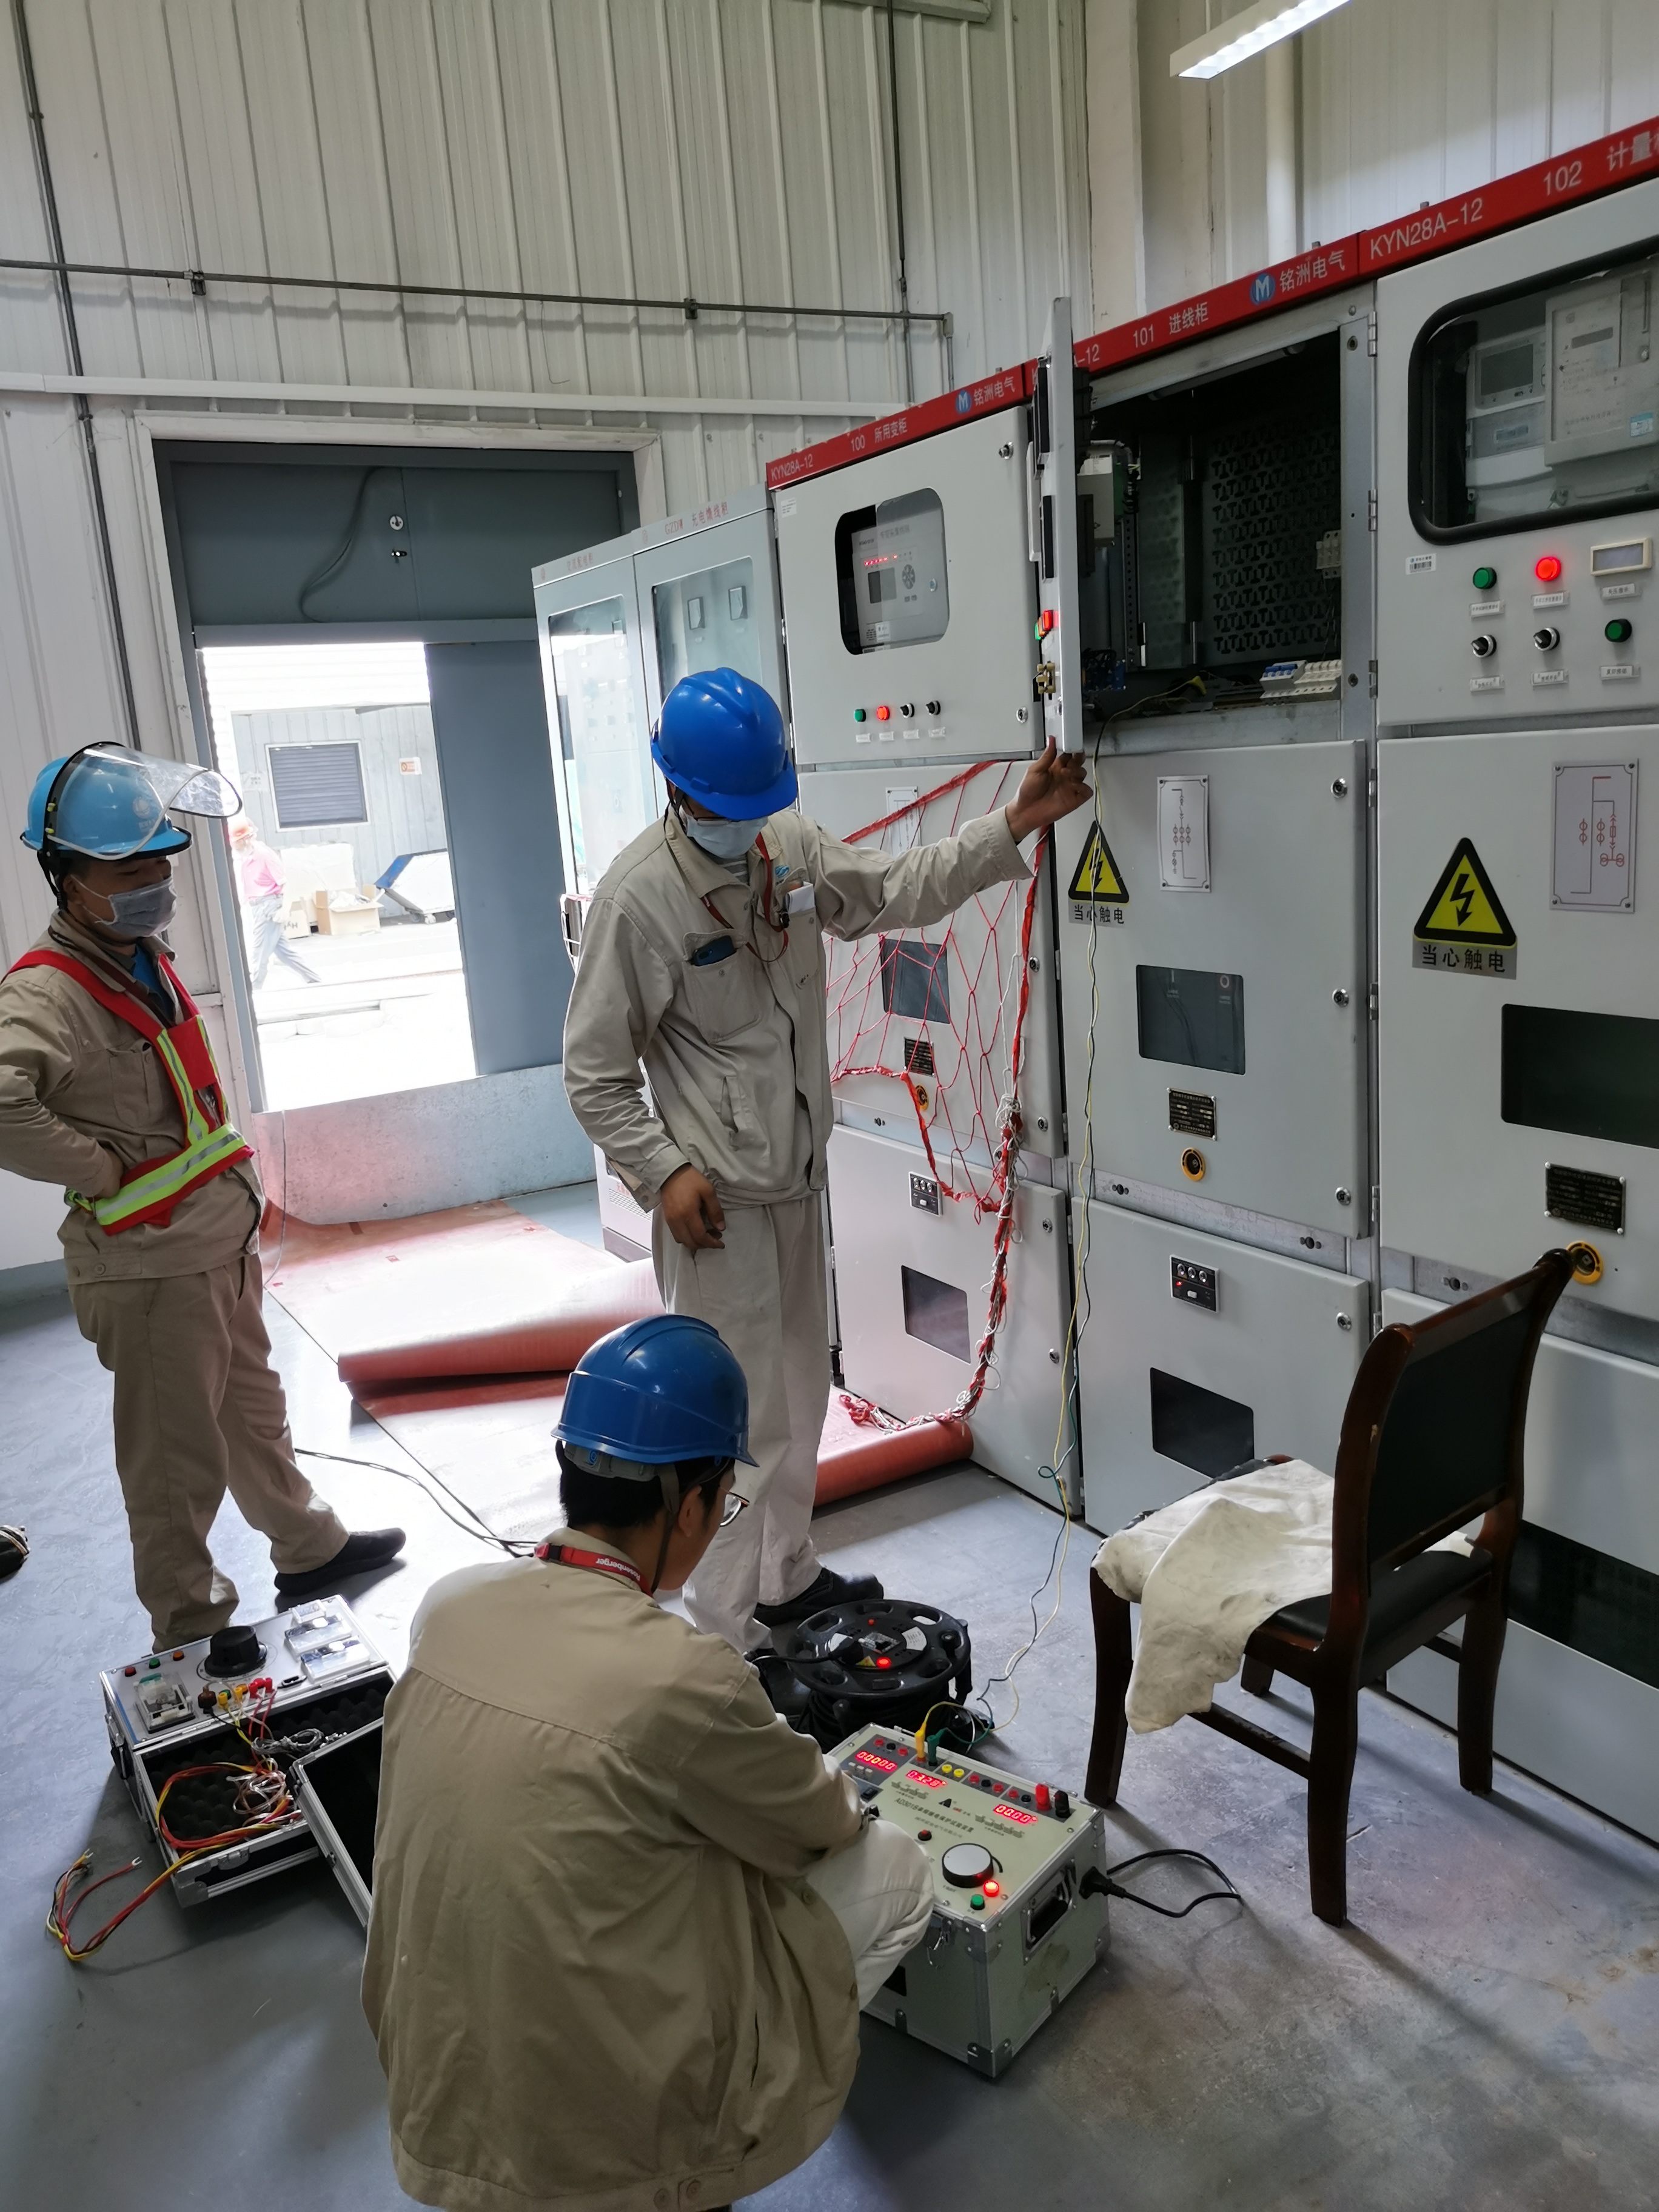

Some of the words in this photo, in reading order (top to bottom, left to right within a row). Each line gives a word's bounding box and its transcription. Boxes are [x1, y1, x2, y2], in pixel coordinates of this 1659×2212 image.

[1370, 197, 1483, 260] KYN28A-12
[1543, 160, 1583, 196] 102
[1133, 324, 1154, 348] 101
[1168, 302, 1209, 335] 进线柜
[1279, 249, 1347, 293] 铭洲电气
[771, 454, 813, 481] KYN28A-12
[851, 435, 865, 452] 100
[874, 417, 908, 443] 所用变柜
[973, 376, 1016, 406] 铭洲电气
[1074, 904, 1125, 925] 当心触电
[1421, 945, 1506, 973] 当心触电
[596, 1558, 640, 1581] Rosenberger
